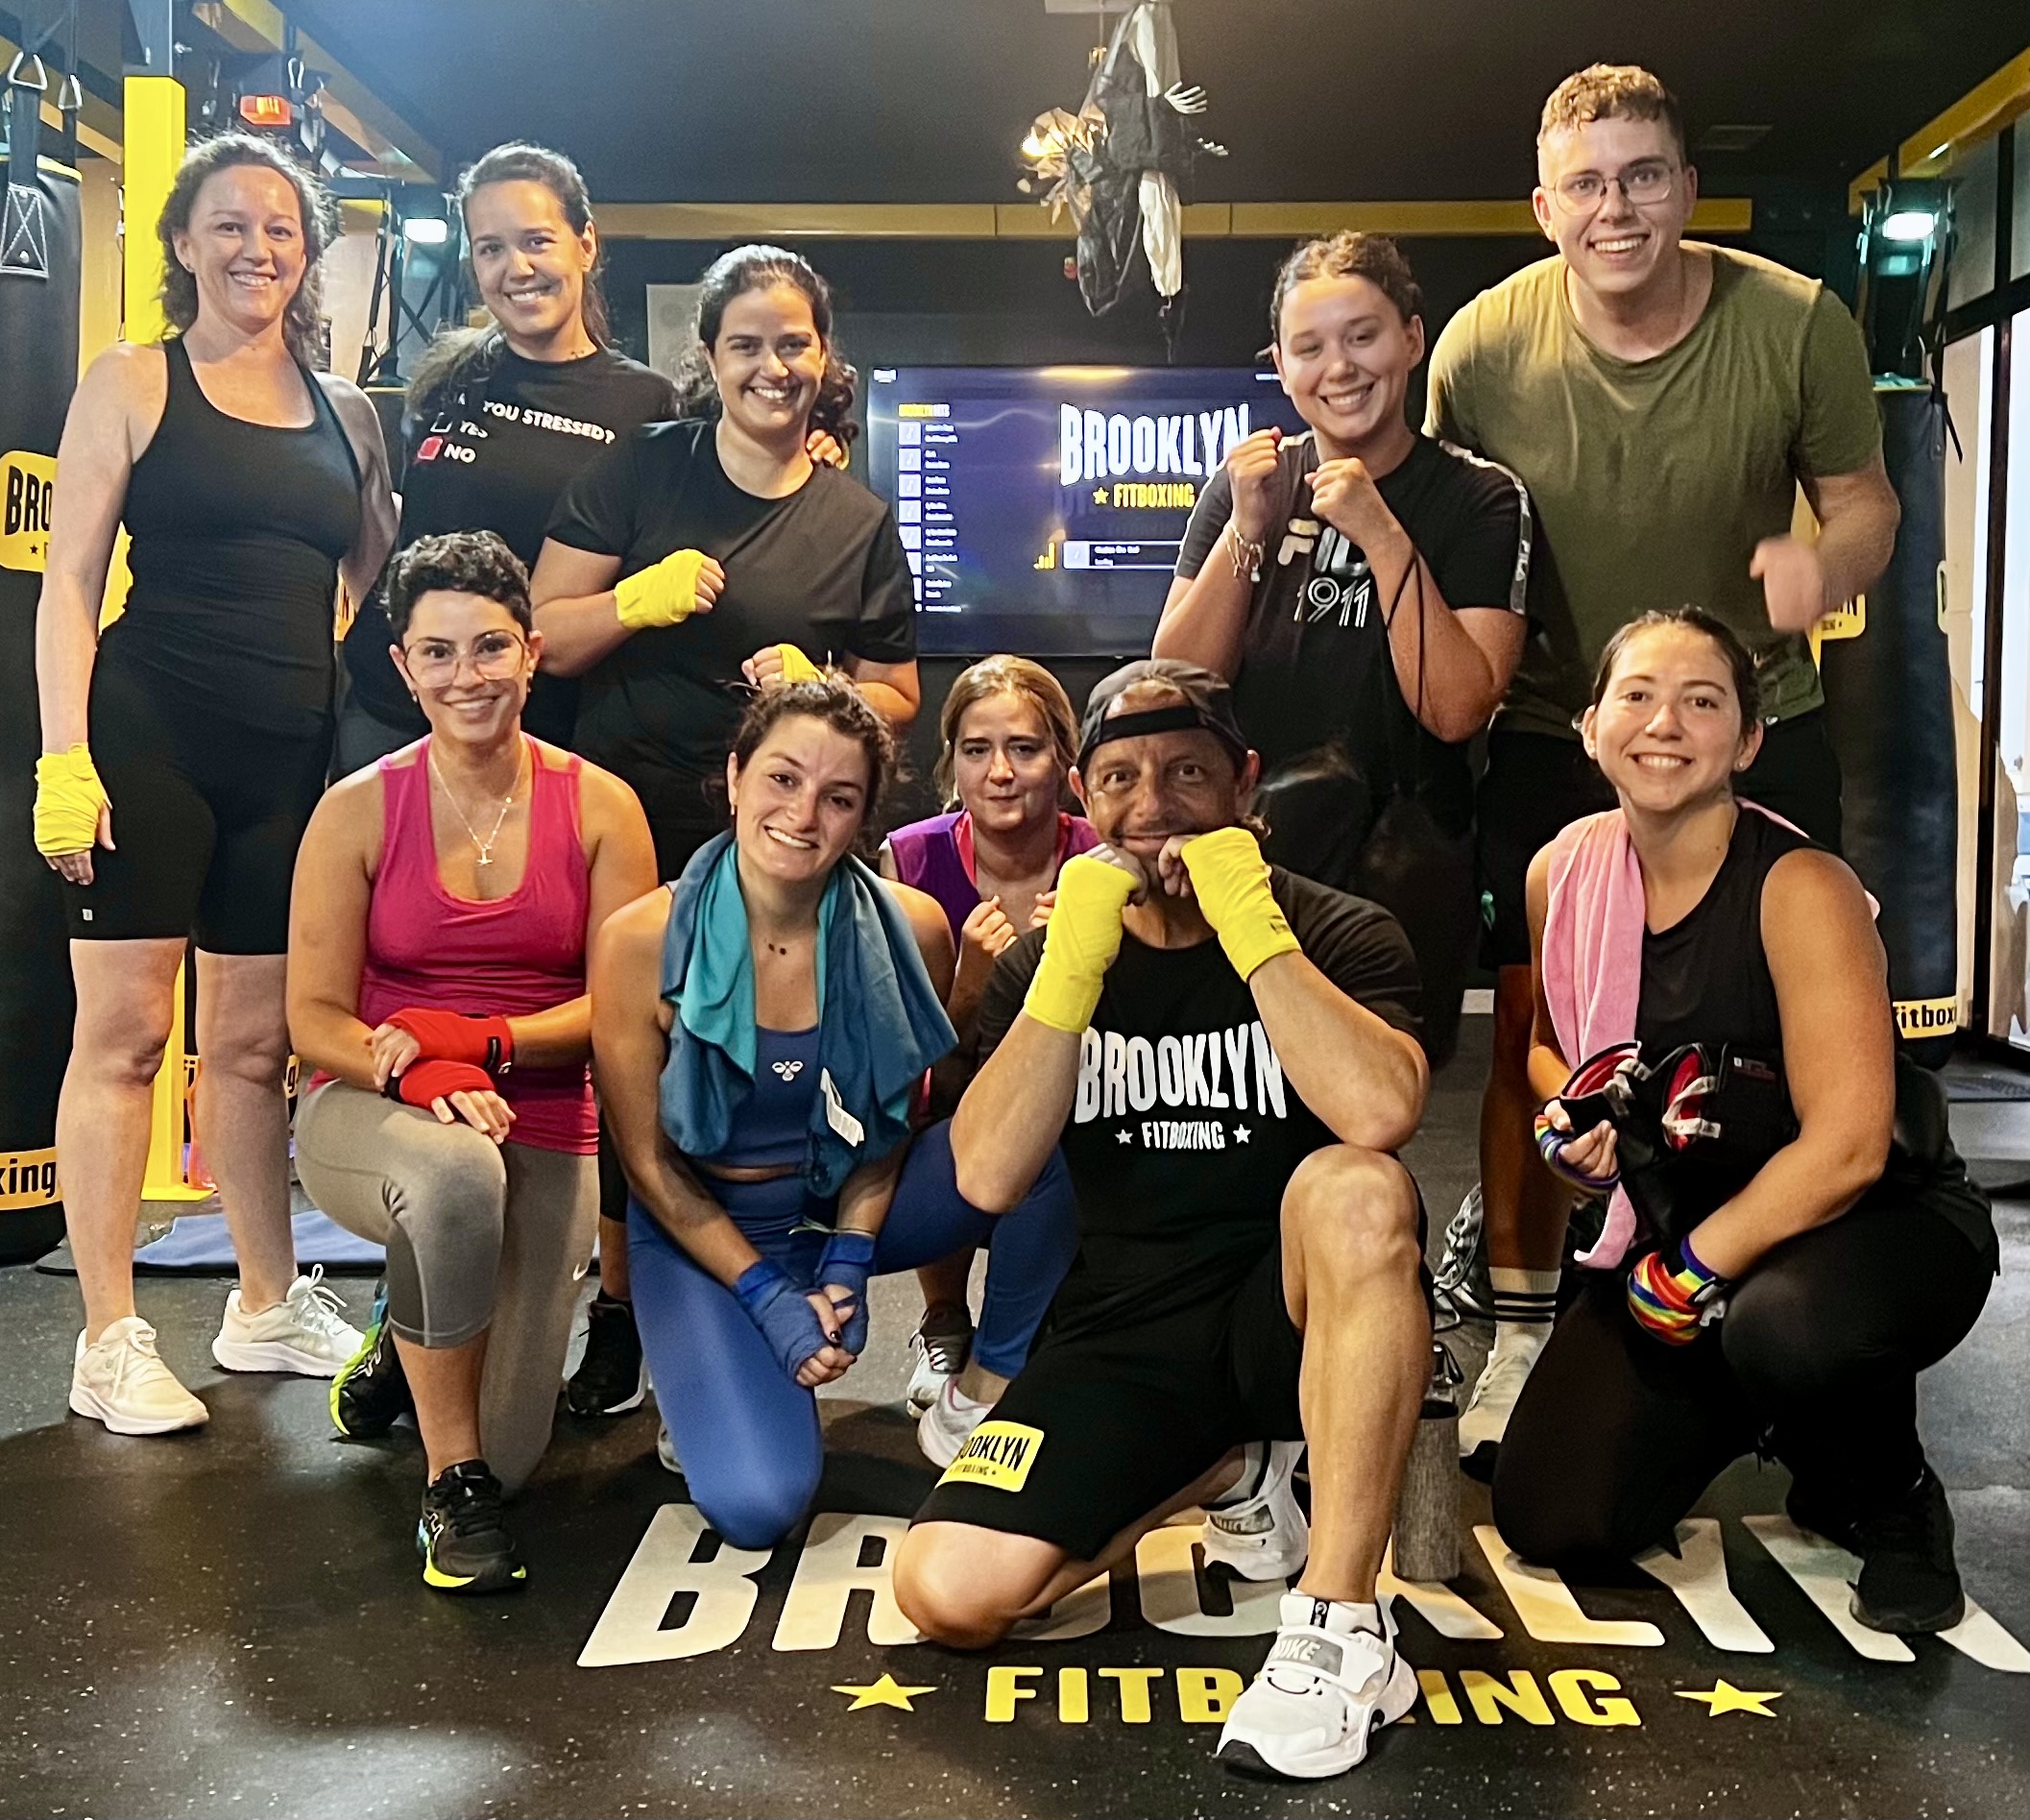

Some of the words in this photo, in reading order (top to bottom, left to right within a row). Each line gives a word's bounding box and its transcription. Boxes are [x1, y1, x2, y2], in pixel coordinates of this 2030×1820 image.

[483, 400, 520, 422] YOU
[521, 408, 616, 445] STRESSED?
[444, 443, 476, 463] NO
[1060, 401, 1249, 487] BROOKLYN
[1113, 483, 1196, 508] FITBOXING
[1075, 1021, 1288, 1124] BROOKLYN
[1141, 1121, 1225, 1150] FITBOXING
[1269, 1637, 1321, 1662] NIKE
[985, 1666, 1641, 1727] FITBING
